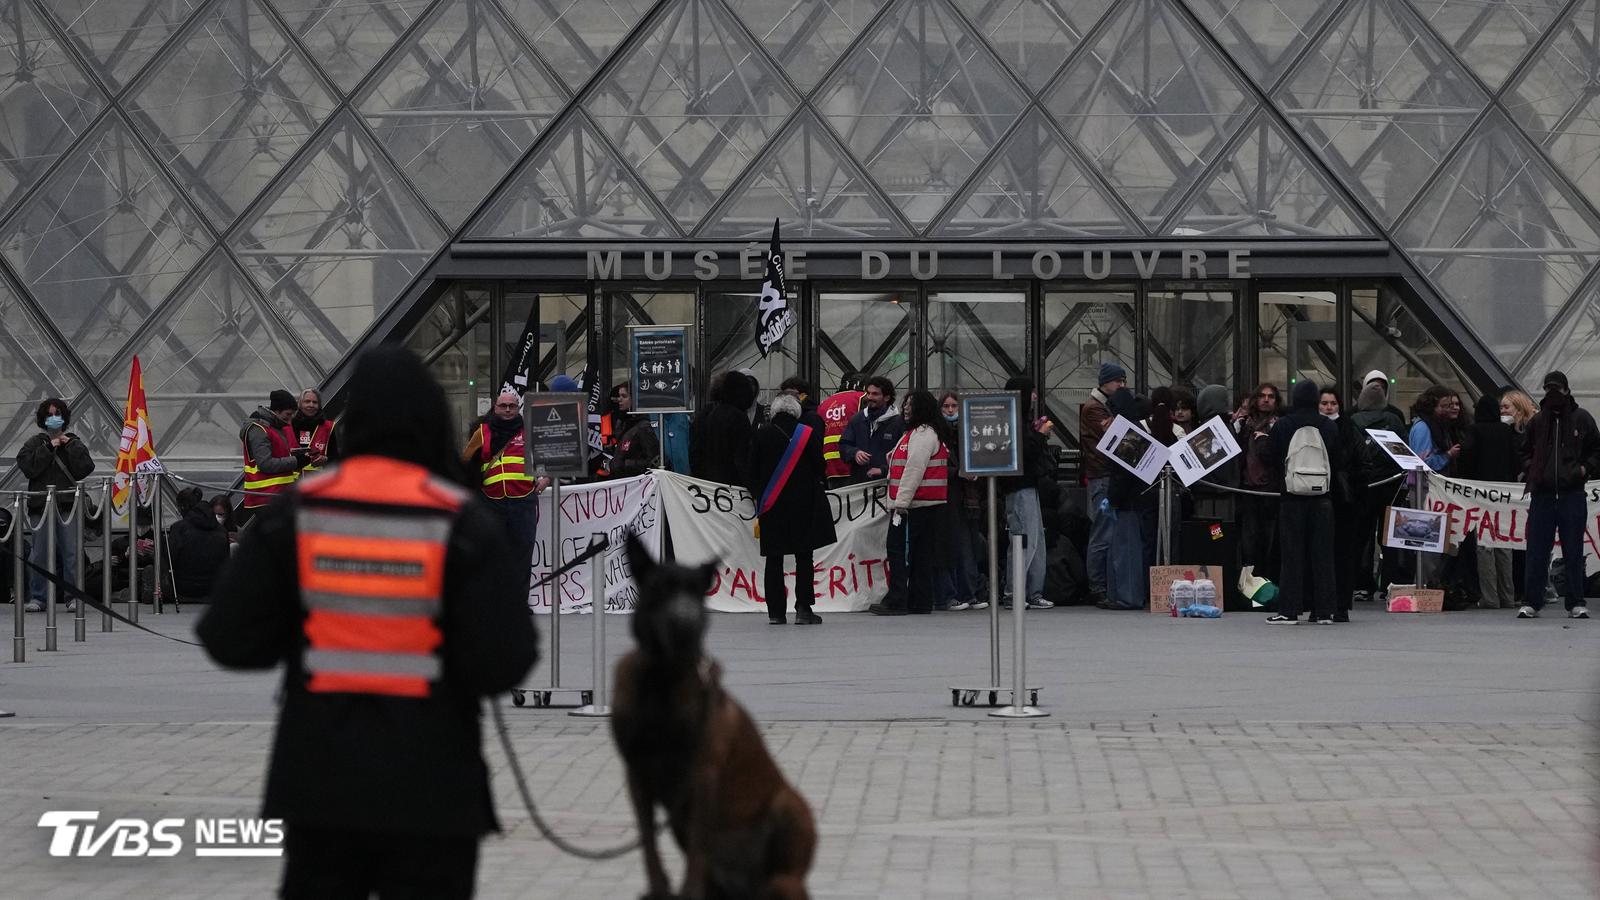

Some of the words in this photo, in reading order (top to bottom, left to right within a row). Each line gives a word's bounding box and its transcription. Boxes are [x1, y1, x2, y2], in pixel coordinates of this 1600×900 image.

[586, 241, 808, 281] MUSÉE
[860, 250, 939, 281] DU
[992, 249, 1252, 281] LOUVRE
[825, 404, 847, 421] cgt
[559, 484, 628, 525] KNOW
[687, 484, 758, 522] 365
[825, 484, 889, 525] OUR
[1444, 481, 1512, 505] FRENCH
[530, 535, 588, 569] OLCE
[528, 570, 586, 609] GERS
